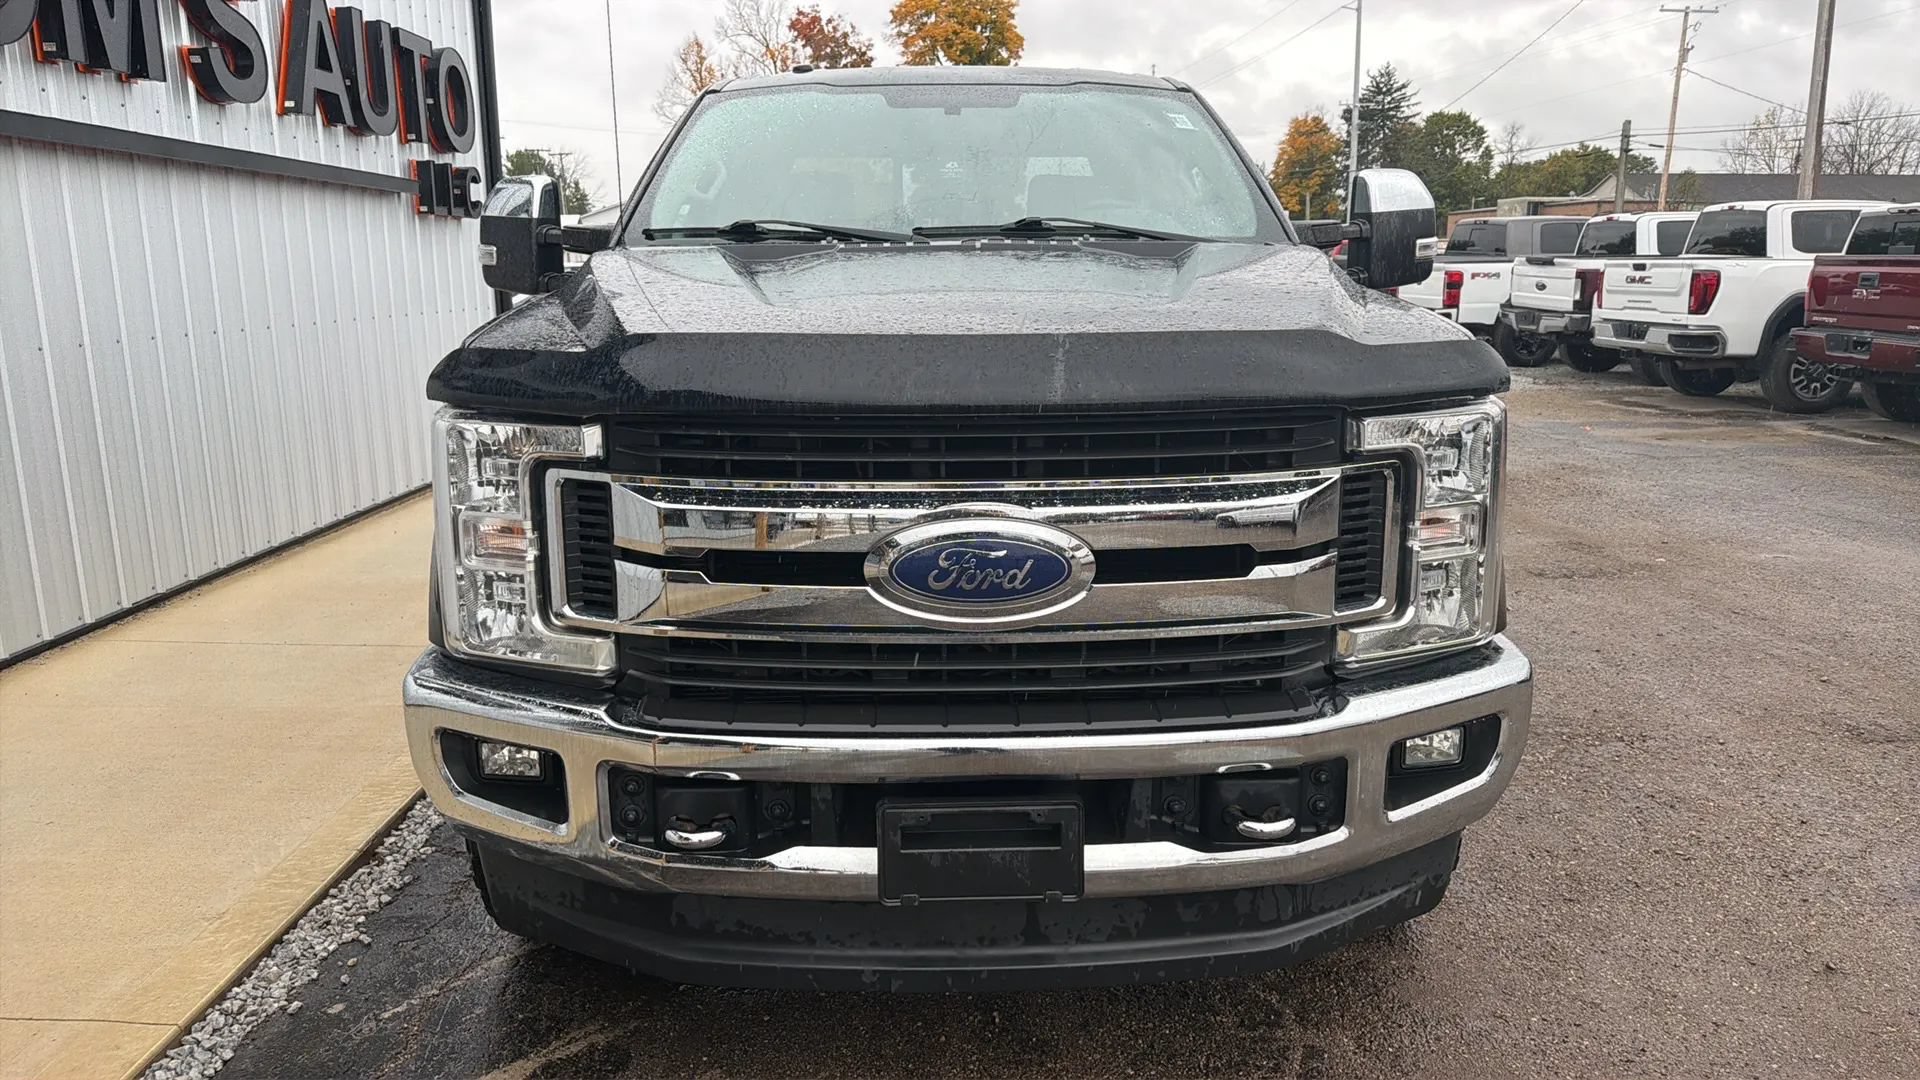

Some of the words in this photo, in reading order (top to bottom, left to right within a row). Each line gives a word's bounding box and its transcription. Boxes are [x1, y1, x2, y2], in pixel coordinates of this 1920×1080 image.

[278, 0, 475, 154] AUTO
[1470, 271, 1501, 281] FX4
[1625, 275, 1653, 285] GMC
[927, 547, 1033, 591] Ford
